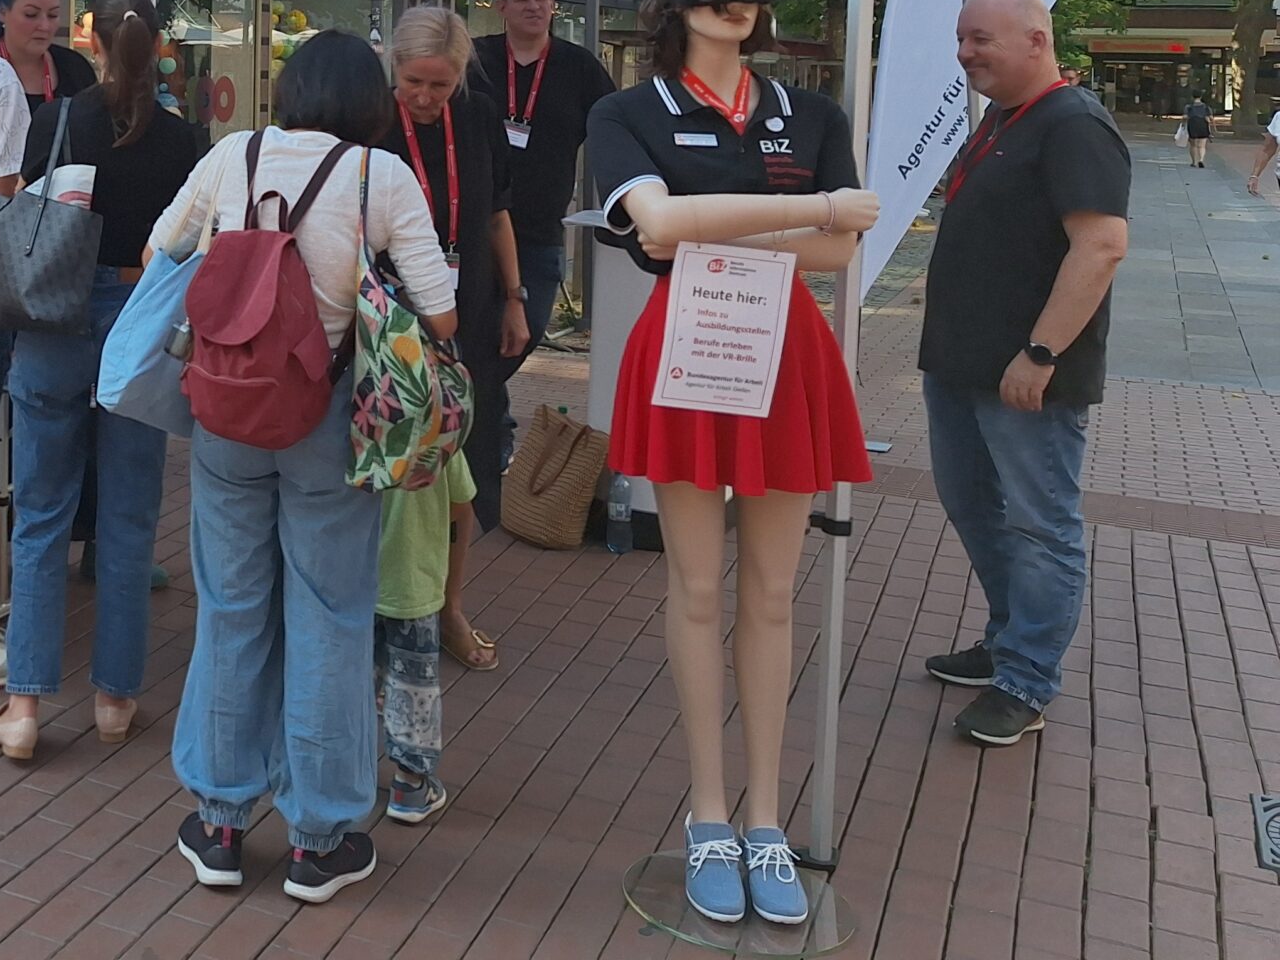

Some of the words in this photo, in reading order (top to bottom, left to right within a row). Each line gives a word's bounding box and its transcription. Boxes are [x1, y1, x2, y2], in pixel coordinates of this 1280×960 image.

[897, 104, 947, 181] Agentur
[943, 75, 966, 106] für
[941, 106, 969, 148] www.a
[759, 138, 793, 154] BiZ
[692, 286, 733, 302] Heute
[737, 290, 767, 306] hier:
[697, 308, 718, 318] Infos
[719, 311, 729, 319] zu
[696, 320, 771, 336] Ausbildungsstellen
[693, 337, 720, 347] Berufe
[722, 340, 753, 351] erleben
[691, 349, 705, 358] mit
[706, 350, 721, 359] der
[722, 353, 757, 363] VR-Brille
